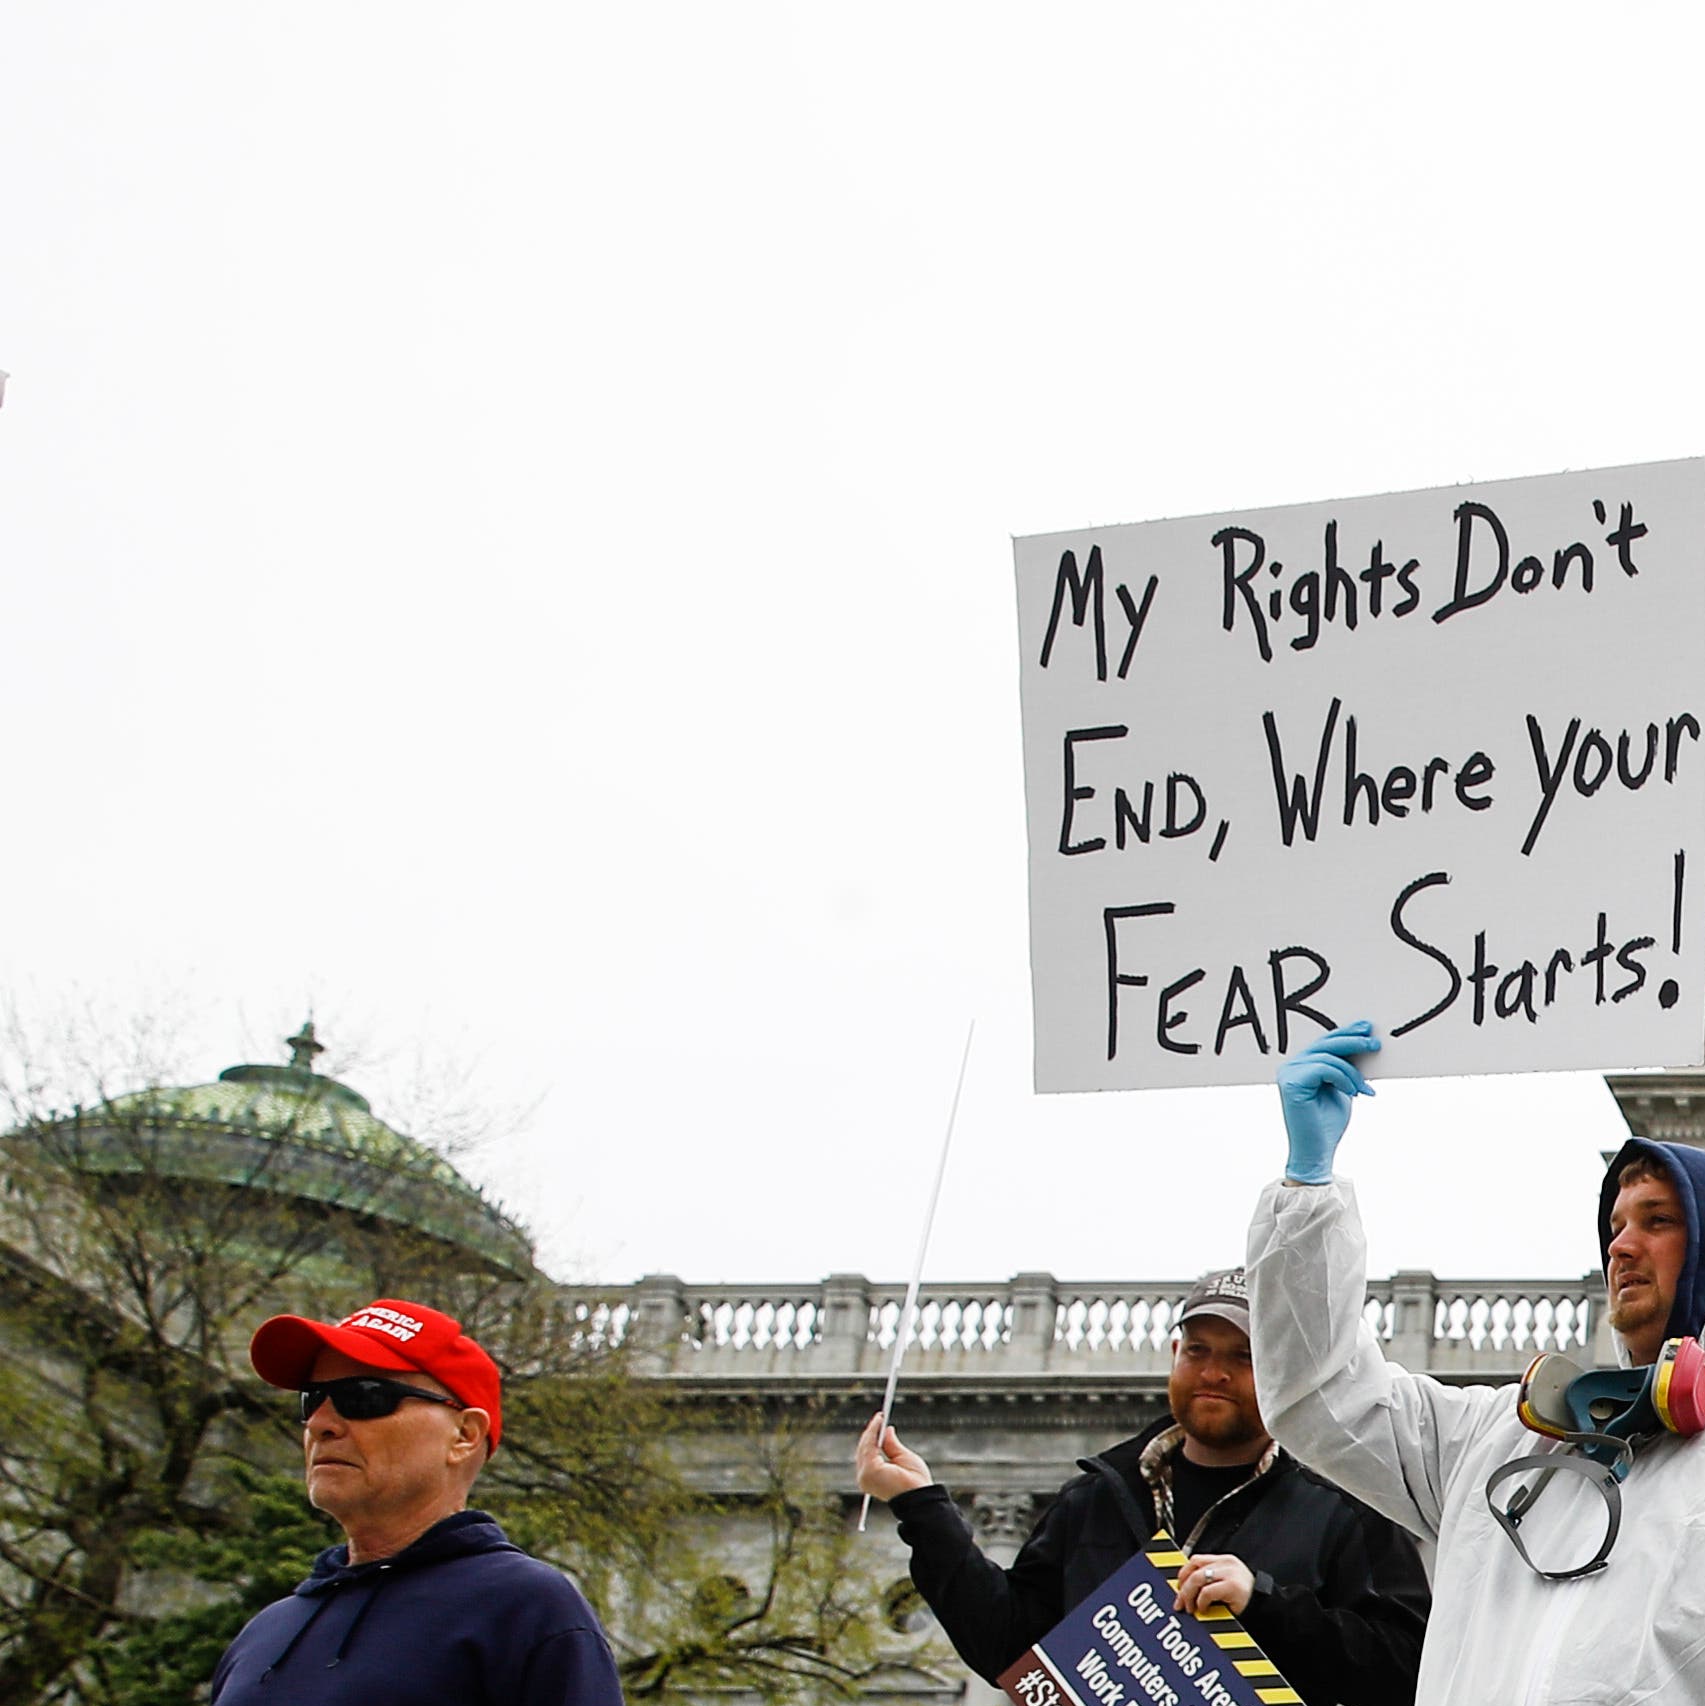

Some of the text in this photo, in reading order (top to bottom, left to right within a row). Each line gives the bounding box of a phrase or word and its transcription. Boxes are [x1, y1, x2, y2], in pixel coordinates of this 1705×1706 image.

[1040, 499, 1650, 681] My Rights Don't
[1262, 696, 1497, 849] Where
[1103, 849, 1686, 1062] FEAR Starts!
[351, 1315, 416, 1342] AGAIN
[352, 1306, 424, 1333] MERICA
[1128, 1582, 1165, 1625] Our
[1156, 1615, 1203, 1678] Tools
